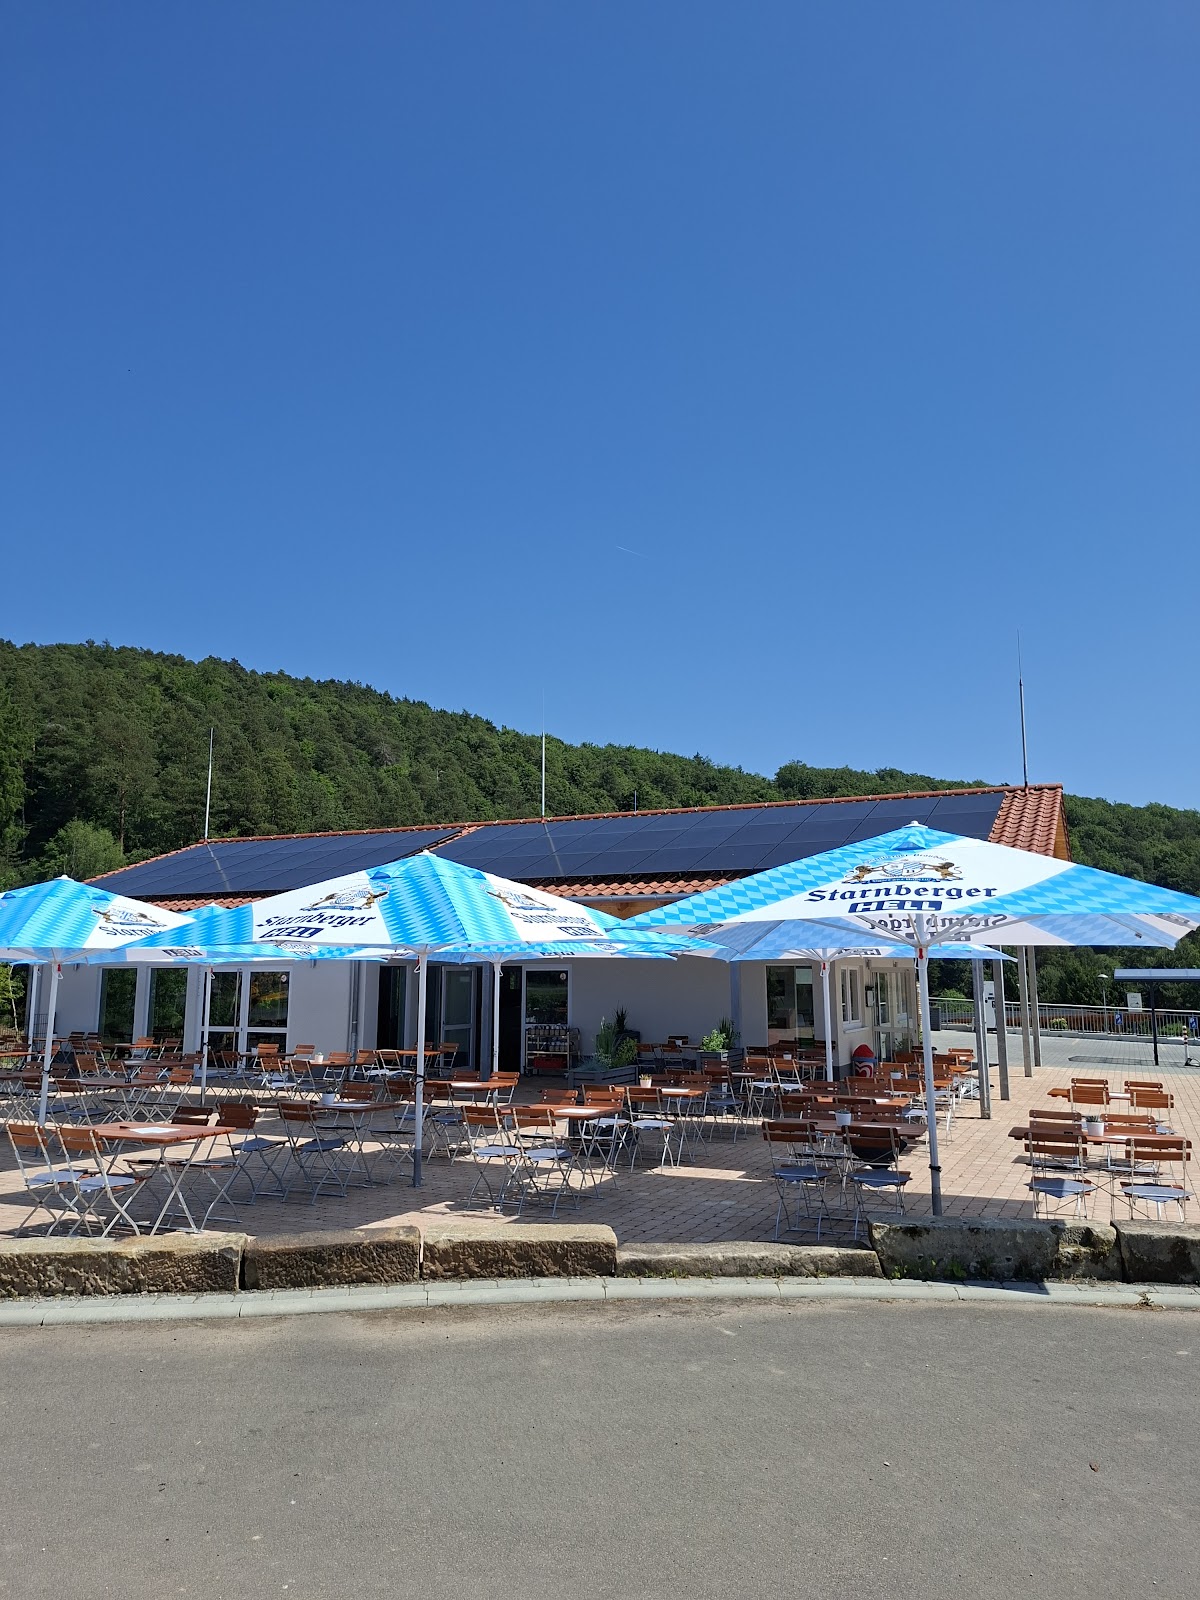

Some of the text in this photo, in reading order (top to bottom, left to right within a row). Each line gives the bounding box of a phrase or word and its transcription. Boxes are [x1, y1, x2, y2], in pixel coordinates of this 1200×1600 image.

[804, 883, 998, 902] Starnberger
[850, 900, 942, 913] HELL
[256, 911, 377, 928] Starnberger
